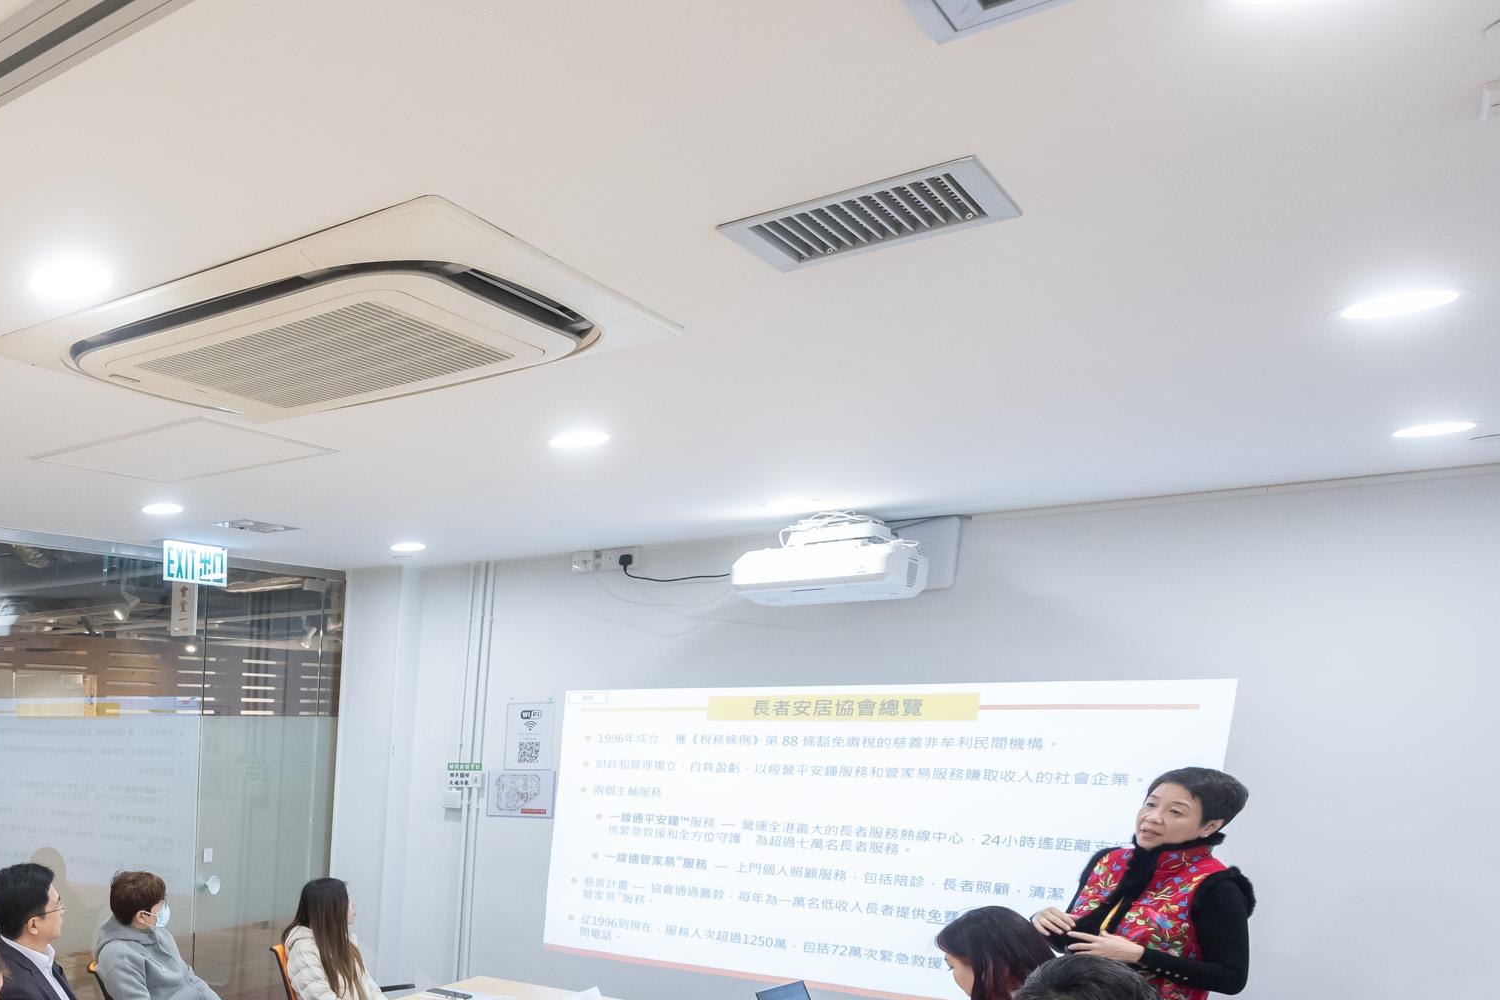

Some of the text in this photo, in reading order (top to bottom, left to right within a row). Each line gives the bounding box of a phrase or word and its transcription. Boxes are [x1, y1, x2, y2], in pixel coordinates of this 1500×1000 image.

[167, 547, 224, 584] EXIT 出口
[753, 697, 924, 717] 長者安居協會總覽
